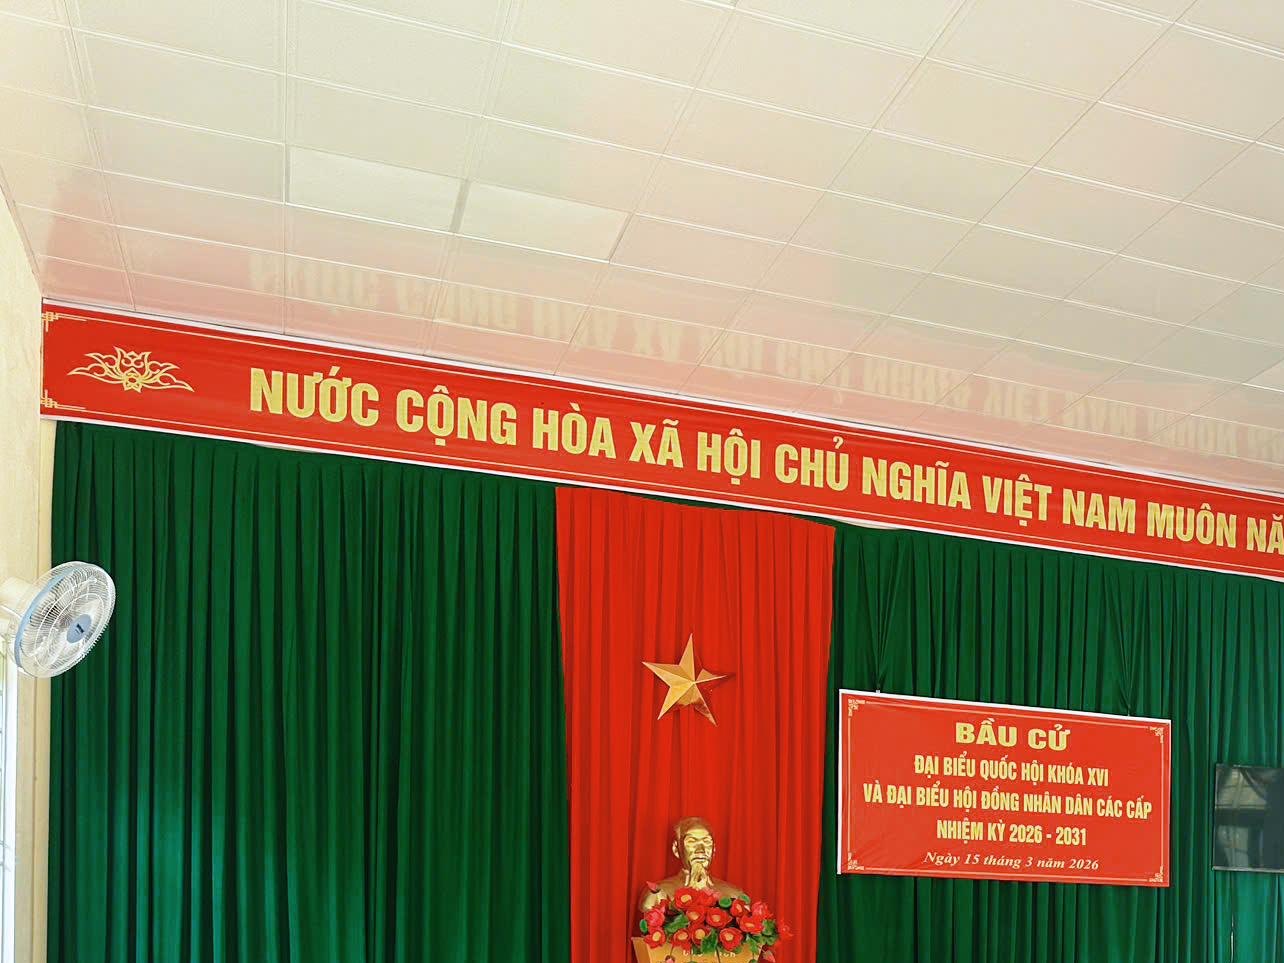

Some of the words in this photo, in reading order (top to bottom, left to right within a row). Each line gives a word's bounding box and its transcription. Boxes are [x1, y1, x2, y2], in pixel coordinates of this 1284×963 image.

[250, 366, 379, 426] NƯỚC
[396, 385, 517, 446] CỘNG
[532, 402, 616, 459] HÒA
[629, 419, 683, 468] XÃ
[697, 428, 760, 485] HỘI
[775, 436, 850, 491] CHỦ
[862, 456, 971, 509] NGHĨA
[982, 475, 1052, 526] VIỆT
[1063, 489, 1136, 534] NAM
[1147, 502, 1236, 548] MUÔN
[955, 718, 1018, 748] BẦU
[1027, 723, 1072, 752] CỬ
[914, 754, 940, 777] ĐẠI
[943, 750, 976, 778] BIỂU
[979, 753, 1018, 781] QUỐC
[1021, 759, 1044, 787] HỘI
[1047, 764, 1085, 786] KHÓA
[1087, 768, 1109, 787] XVI
[863, 780, 883, 804] VÀ
[886, 784, 912, 808] ĐẠI
[915, 782, 950, 808] BIỂU
[953, 785, 977, 812] HỘI
[980, 784, 1020, 813] ĐỒNG
[1023, 790, 1062, 815] NHÂN
[1065, 792, 1093, 817] DÂN
[1096, 795, 1123, 819] CÁC
[1126, 794, 1153, 820] CẤP
[936, 819, 984, 845] NHIỆM
[987, 818, 1006, 843] KỲ
[1008, 823, 1043, 844] 2026
[1055, 827, 1087, 846] 2031
[923, 851, 961, 869] Ngày
[964, 853, 981, 865] 15
[983, 855, 1022, 870] tháng
[1024, 856, 1034, 867] 3
[1036, 857, 1065, 869] năm
[1068, 858, 1100, 870] 2026
